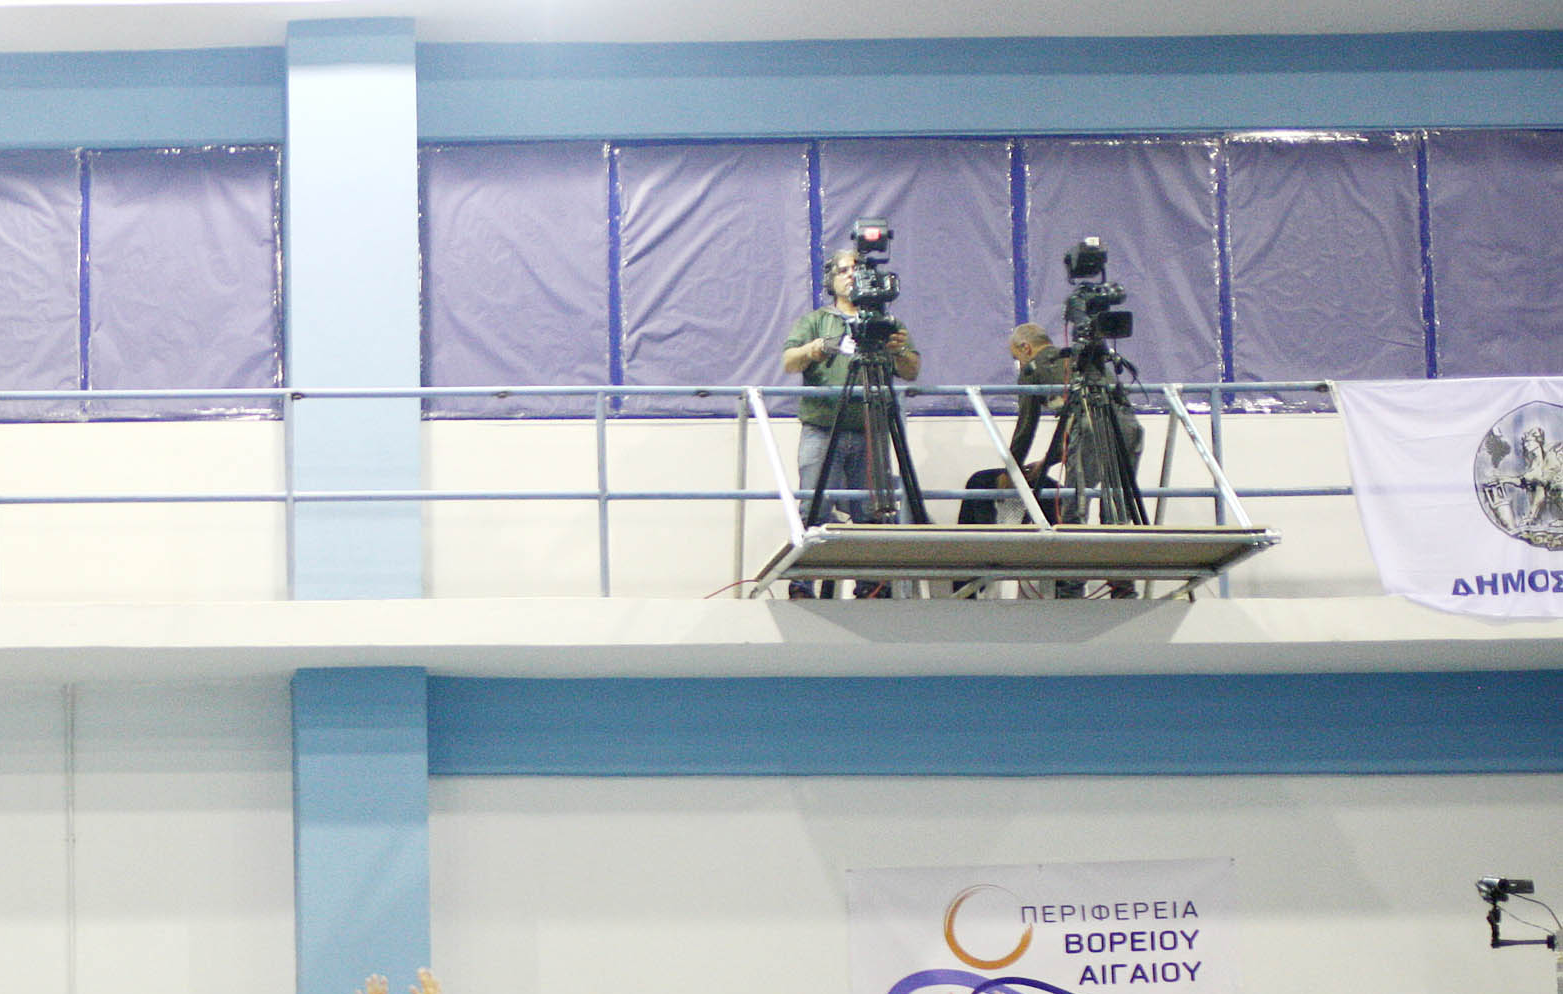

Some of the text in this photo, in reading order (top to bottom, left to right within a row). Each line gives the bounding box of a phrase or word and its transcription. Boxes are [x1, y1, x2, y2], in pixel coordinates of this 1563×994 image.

[1021, 900, 1199, 924] ΠΕΡΙΦΕΡΕΙΑ
[1065, 929, 1200, 954] ΒΟΡΕΙΟΥ
[1079, 961, 1201, 985] ΑΙΓΑΙΟΥ
